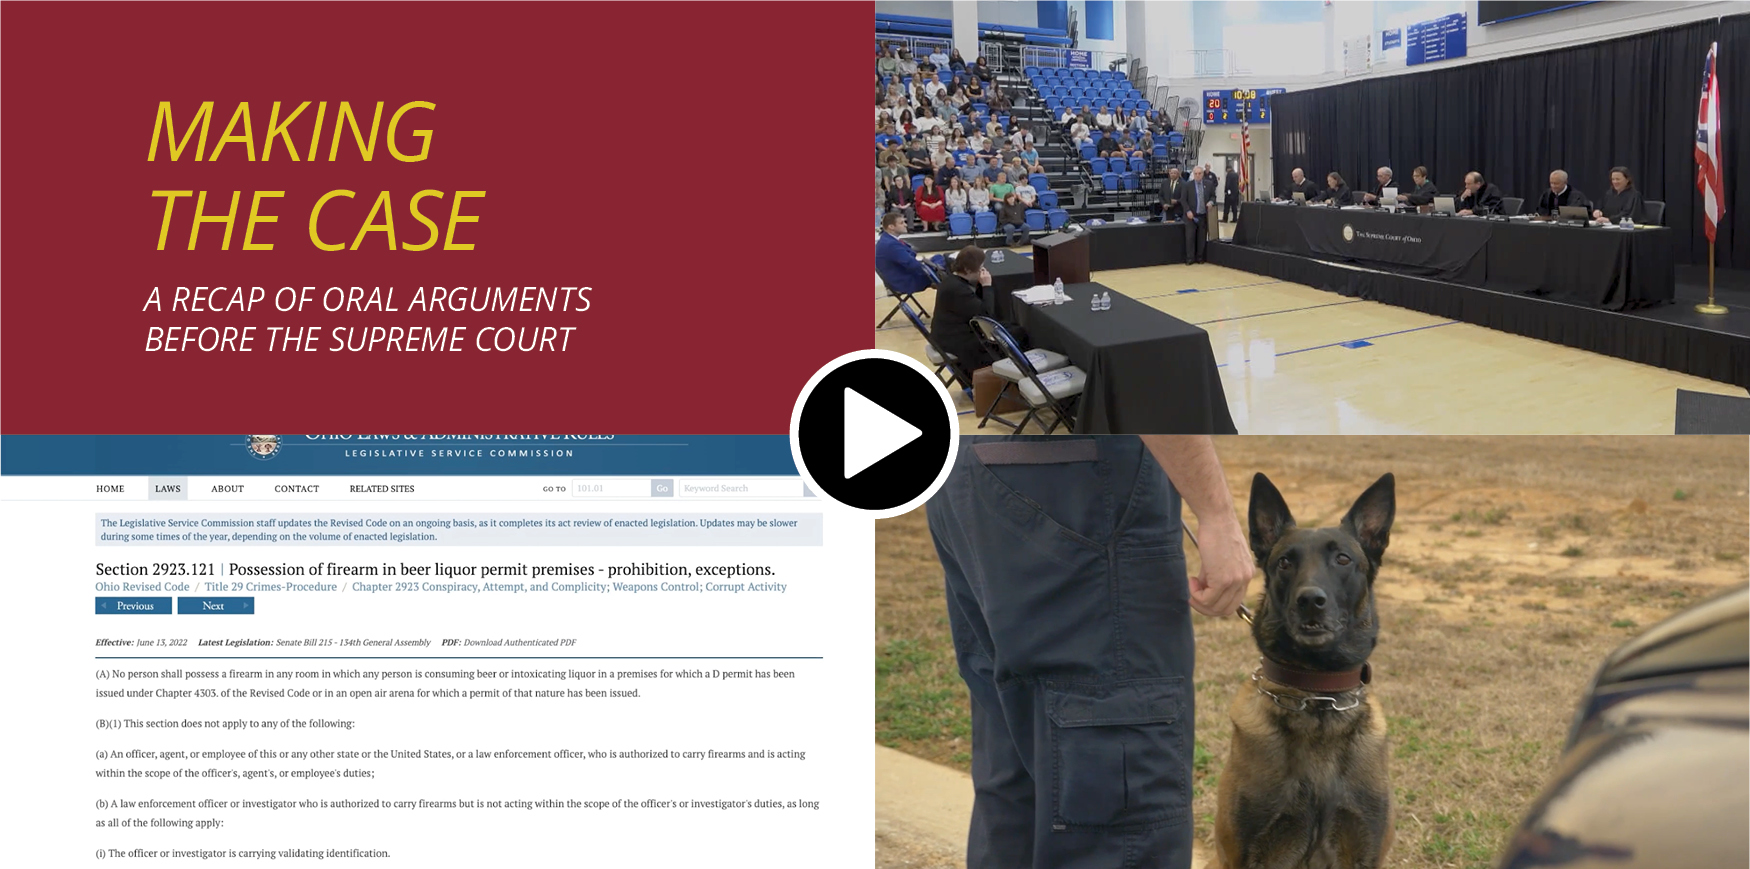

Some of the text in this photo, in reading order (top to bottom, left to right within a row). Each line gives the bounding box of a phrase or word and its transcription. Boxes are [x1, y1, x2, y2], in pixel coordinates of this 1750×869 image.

[1209, 99, 1220, 108] 20
[345, 449, 573, 458] LEGISLATIVE SERVICE COMMISSION
[96, 484, 125, 493] HOME
[155, 484, 181, 493] LAWS
[210, 484, 245, 493] ABOUT
[274, 484, 320, 493] CONTACT
[349, 484, 415, 493] RELATED SITES
[542, 485, 567, 493] GO TO
[577, 484, 604, 493] 101.01
[656, 484, 669, 493] Go
[683, 483, 749, 494] Keyword Search
[100, 518, 798, 530] The Legislative Service Commission staff updates the Revised Code on an ongoing basis, as it completes its act review of enacted legislation. Updates may be slower
[100, 531, 438, 543] during some times of the year, depending on the volume of enacted legislation.
[95, 562, 776, 579] Section 2923.121 Possession of firearm in beer liquor permit premises prohibition, exceptions.
[94, 581, 788, 594] Ohio Revised Code Title 29 Crimes-Procedure Chapter 2923 Conspiracy, Attempt, and Complicity; Weapons Control; Corrupt Activity
[117, 600, 155, 611] Previous
[202, 600, 225, 611] Next
[95, 638, 188, 647] Effective: June 13, 2022
[197, 638, 432, 648] Latest Legislation: Senate Bill 215 134th General Assembly
[441, 638, 577, 647] PDF: Download Authenticated PDF
[95, 718, 356, 731] (B)(1) This section does not apply to any of the following:
[95, 848, 391, 860] (i) The officer or investigator is carrying validating identification.
